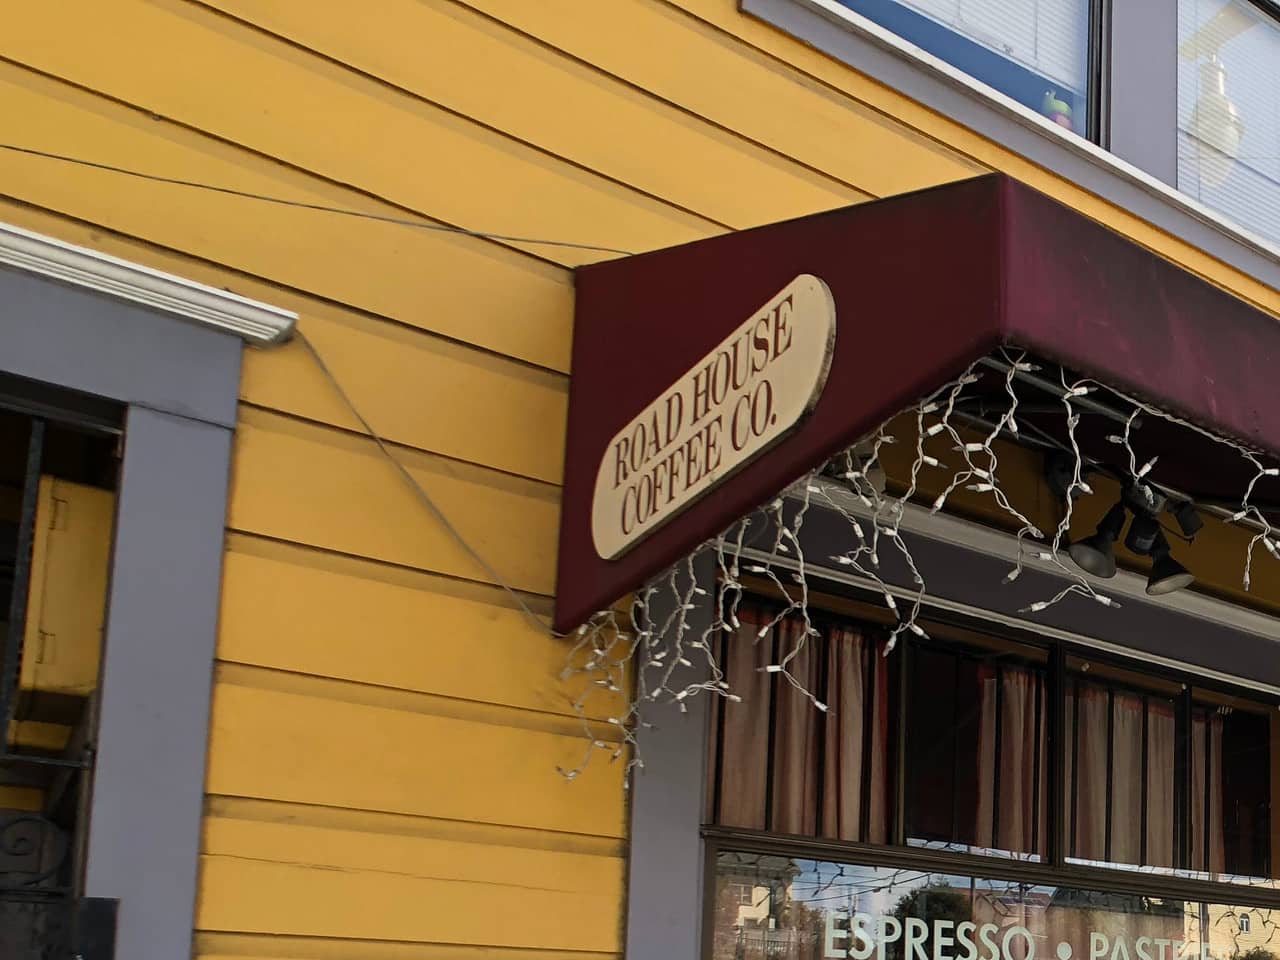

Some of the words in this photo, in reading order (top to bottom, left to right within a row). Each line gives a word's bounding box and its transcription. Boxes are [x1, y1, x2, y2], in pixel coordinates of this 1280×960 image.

[614, 391, 684, 489] ROAD
[690, 294, 793, 426] HOUSE
[621, 415, 722, 535] COFFEE
[731, 379, 777, 451] CO.
